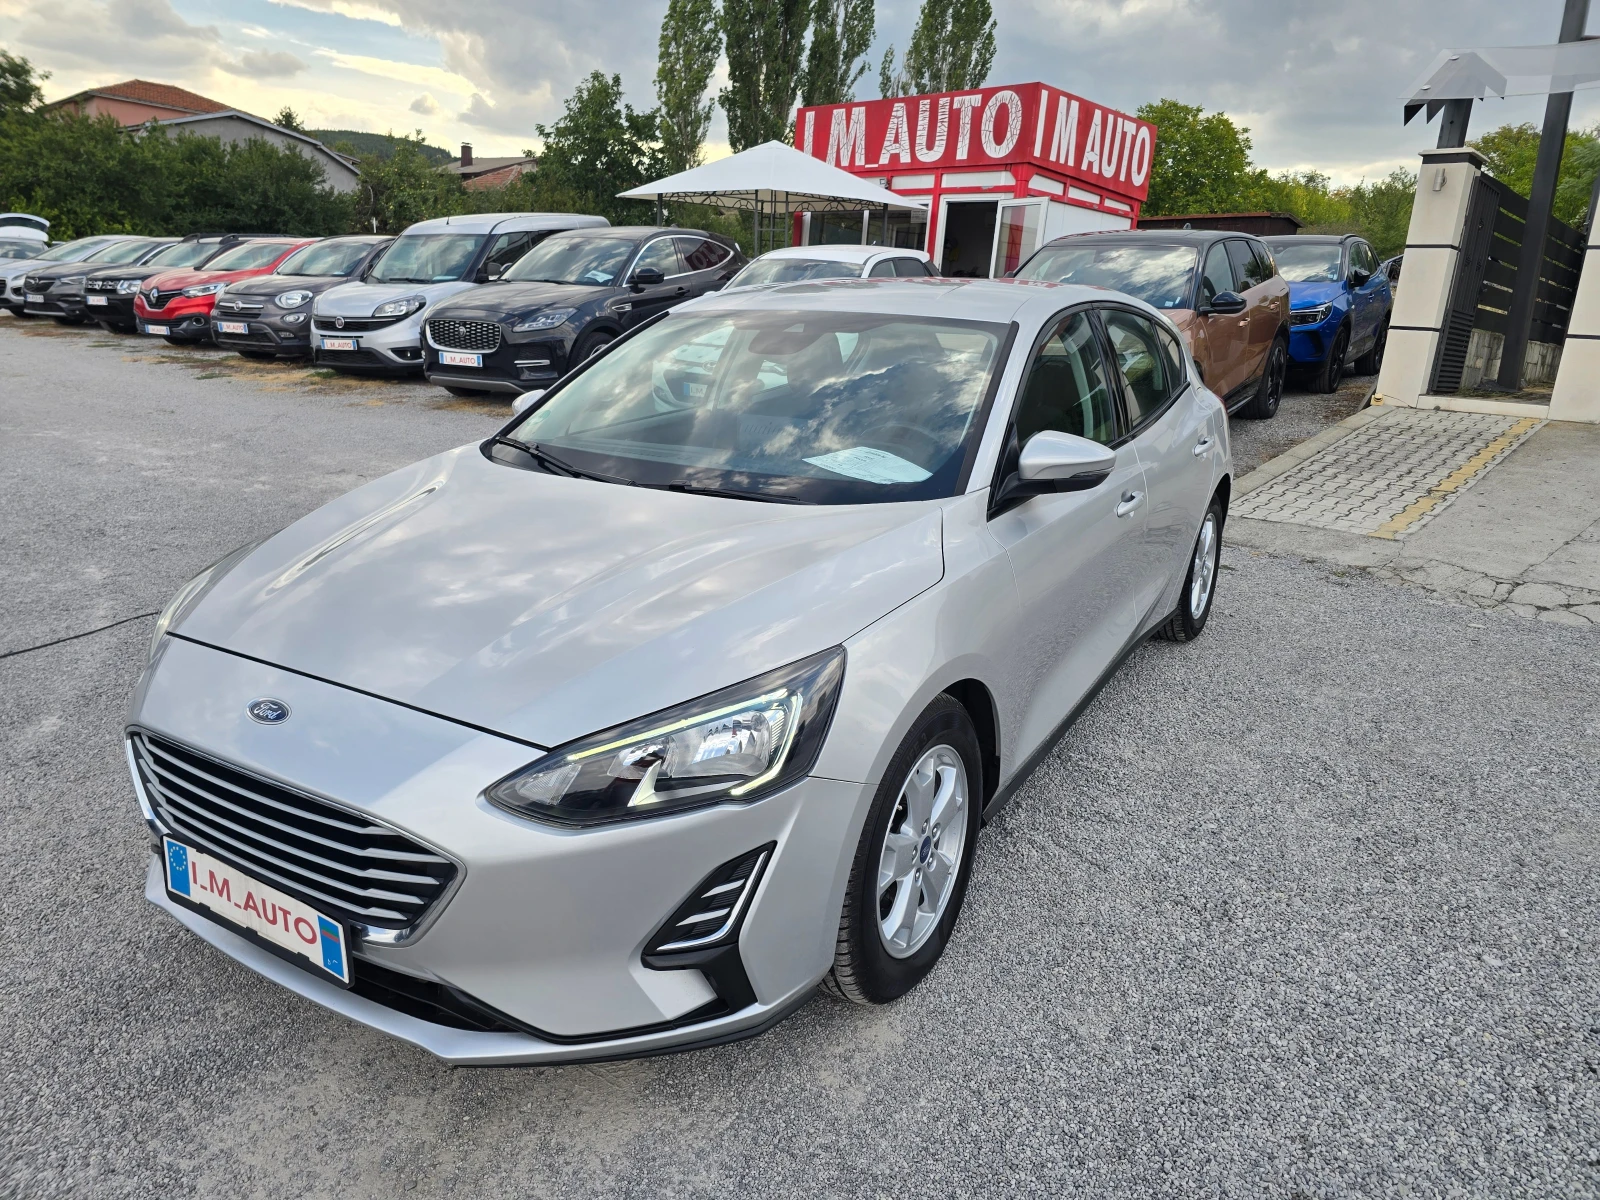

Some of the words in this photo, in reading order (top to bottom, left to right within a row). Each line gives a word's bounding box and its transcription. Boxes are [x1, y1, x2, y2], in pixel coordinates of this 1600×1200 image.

[1033, 89, 1049, 158] I
[1049, 95, 1080, 167] M
[1081, 108, 1151, 187] AUTO
[253, 702, 282, 720] Ford
